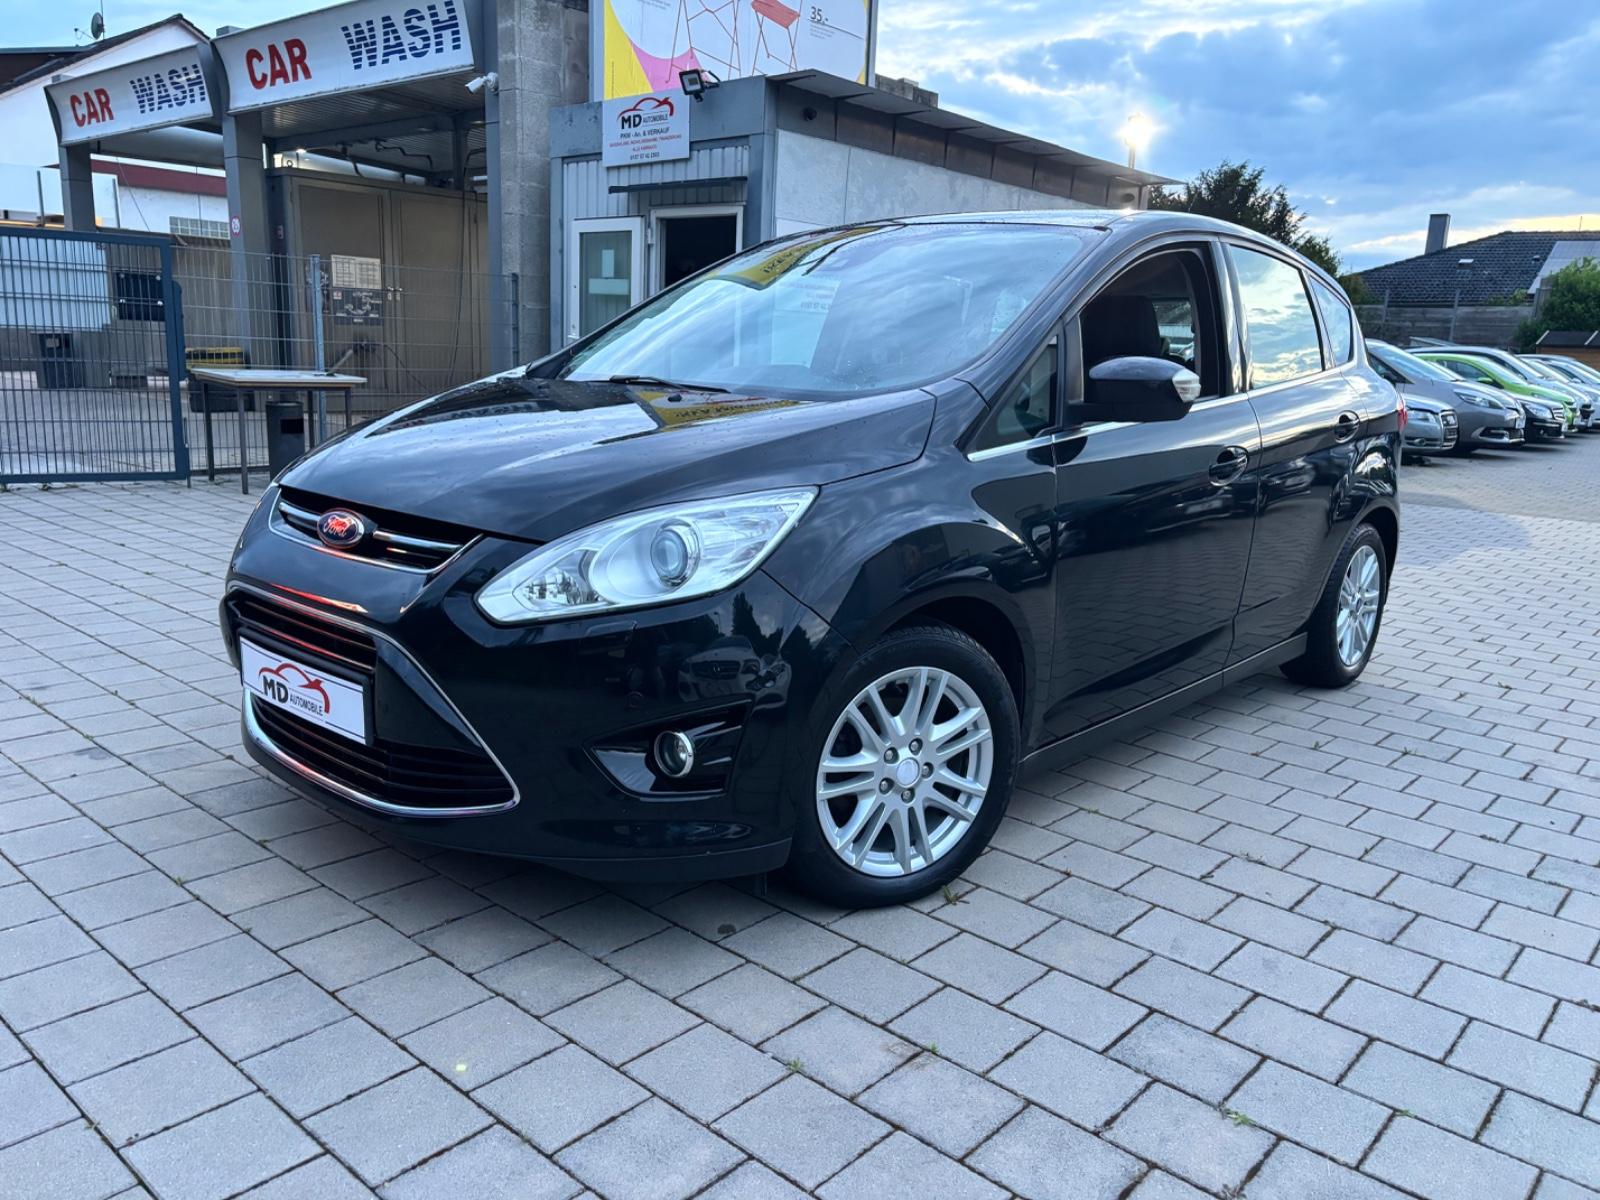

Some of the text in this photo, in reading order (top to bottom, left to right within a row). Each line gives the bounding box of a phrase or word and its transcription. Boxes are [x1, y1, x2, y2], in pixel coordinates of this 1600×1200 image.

[245, 0, 462, 90] CAR WASH
[70, 63, 206, 127] CAR WASH
[621, 114, 642, 129] MD
[262, 674, 324, 717] MD AUTOMOBILE
